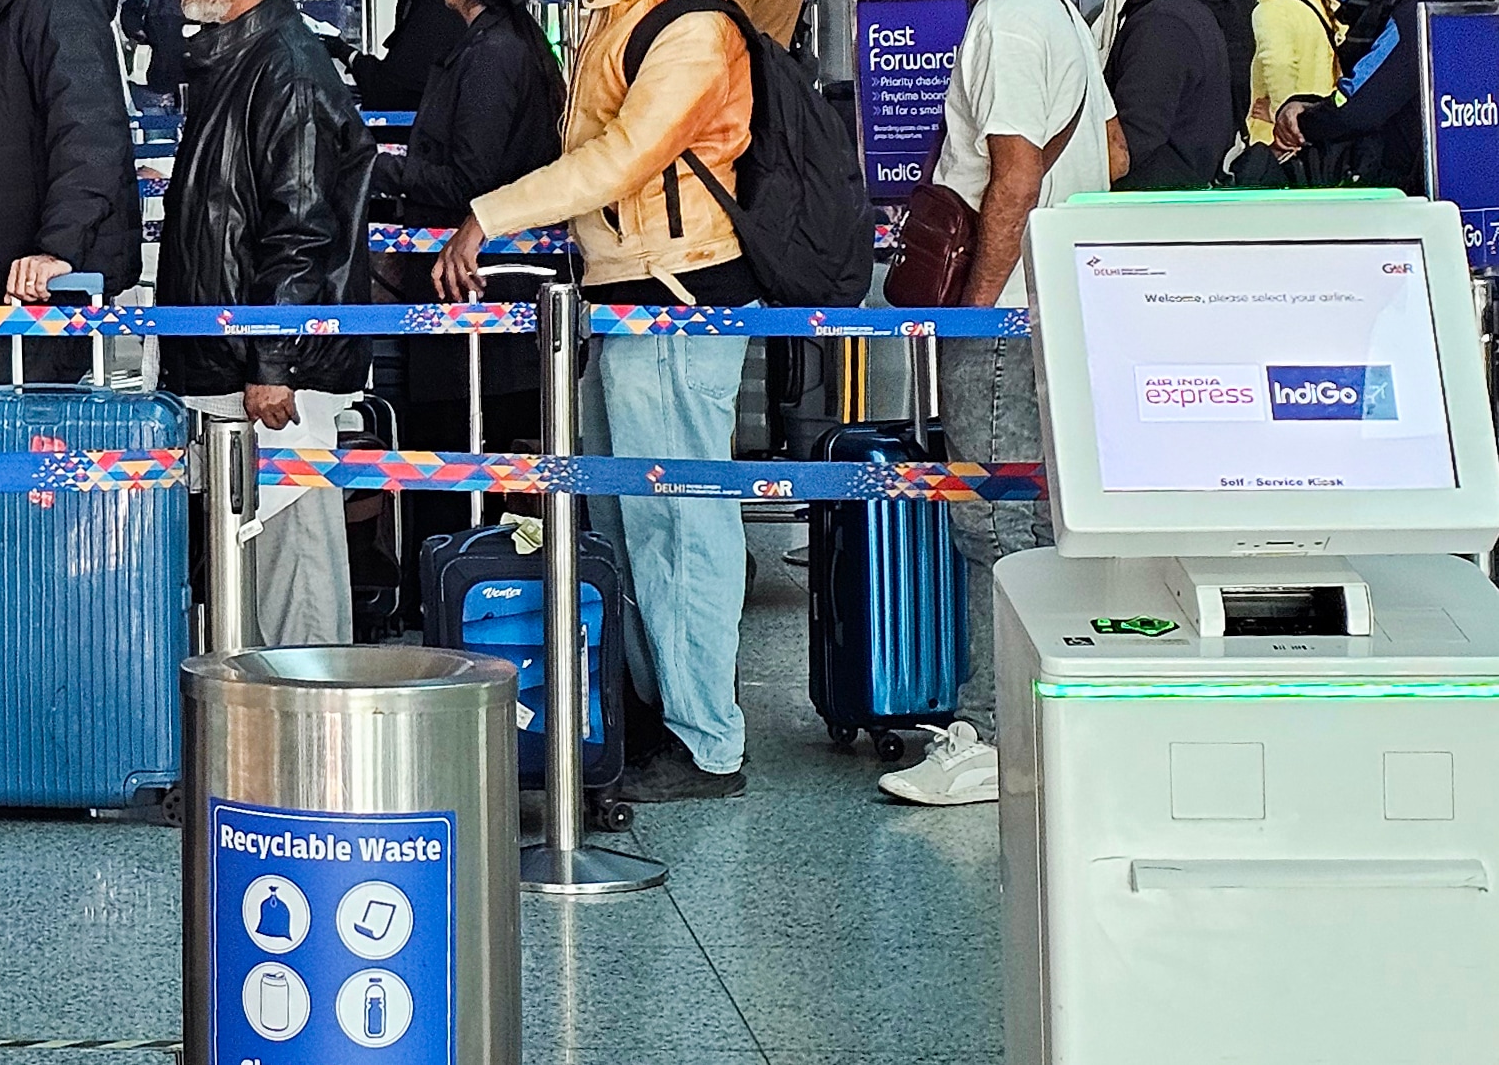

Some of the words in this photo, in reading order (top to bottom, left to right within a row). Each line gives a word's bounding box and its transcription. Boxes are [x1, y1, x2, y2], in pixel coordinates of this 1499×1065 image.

[869, 23, 915, 47] Fast
[870, 45, 958, 71] Forward
[880, 75, 914, 89] Priority
[881, 90, 919, 103] Anytime
[882, 104, 894, 115] All
[896, 104, 909, 115] for
[910, 107, 918, 115] a
[919, 104, 943, 115] small
[1440, 93, 1498, 128] Stretch
[877, 163, 922, 182] IndiG
[1144, 293, 1205, 305] Welcome,
[1208, 292, 1249, 304] please
[1251, 292, 1287, 303] select
[1290, 294, 1316, 305] your
[1146, 377, 1172, 386] AIR
[1176, 377, 1221, 386] INDIA
[1145, 384, 1254, 409] express
[1274, 381, 1358, 405] IndiGo
[654, 483, 685, 494] DELHI
[1220, 477, 1245, 486] Self
[1255, 477, 1303, 487] Service
[220, 824, 351, 862] Recyclable
[358, 836, 441, 863] Waste
